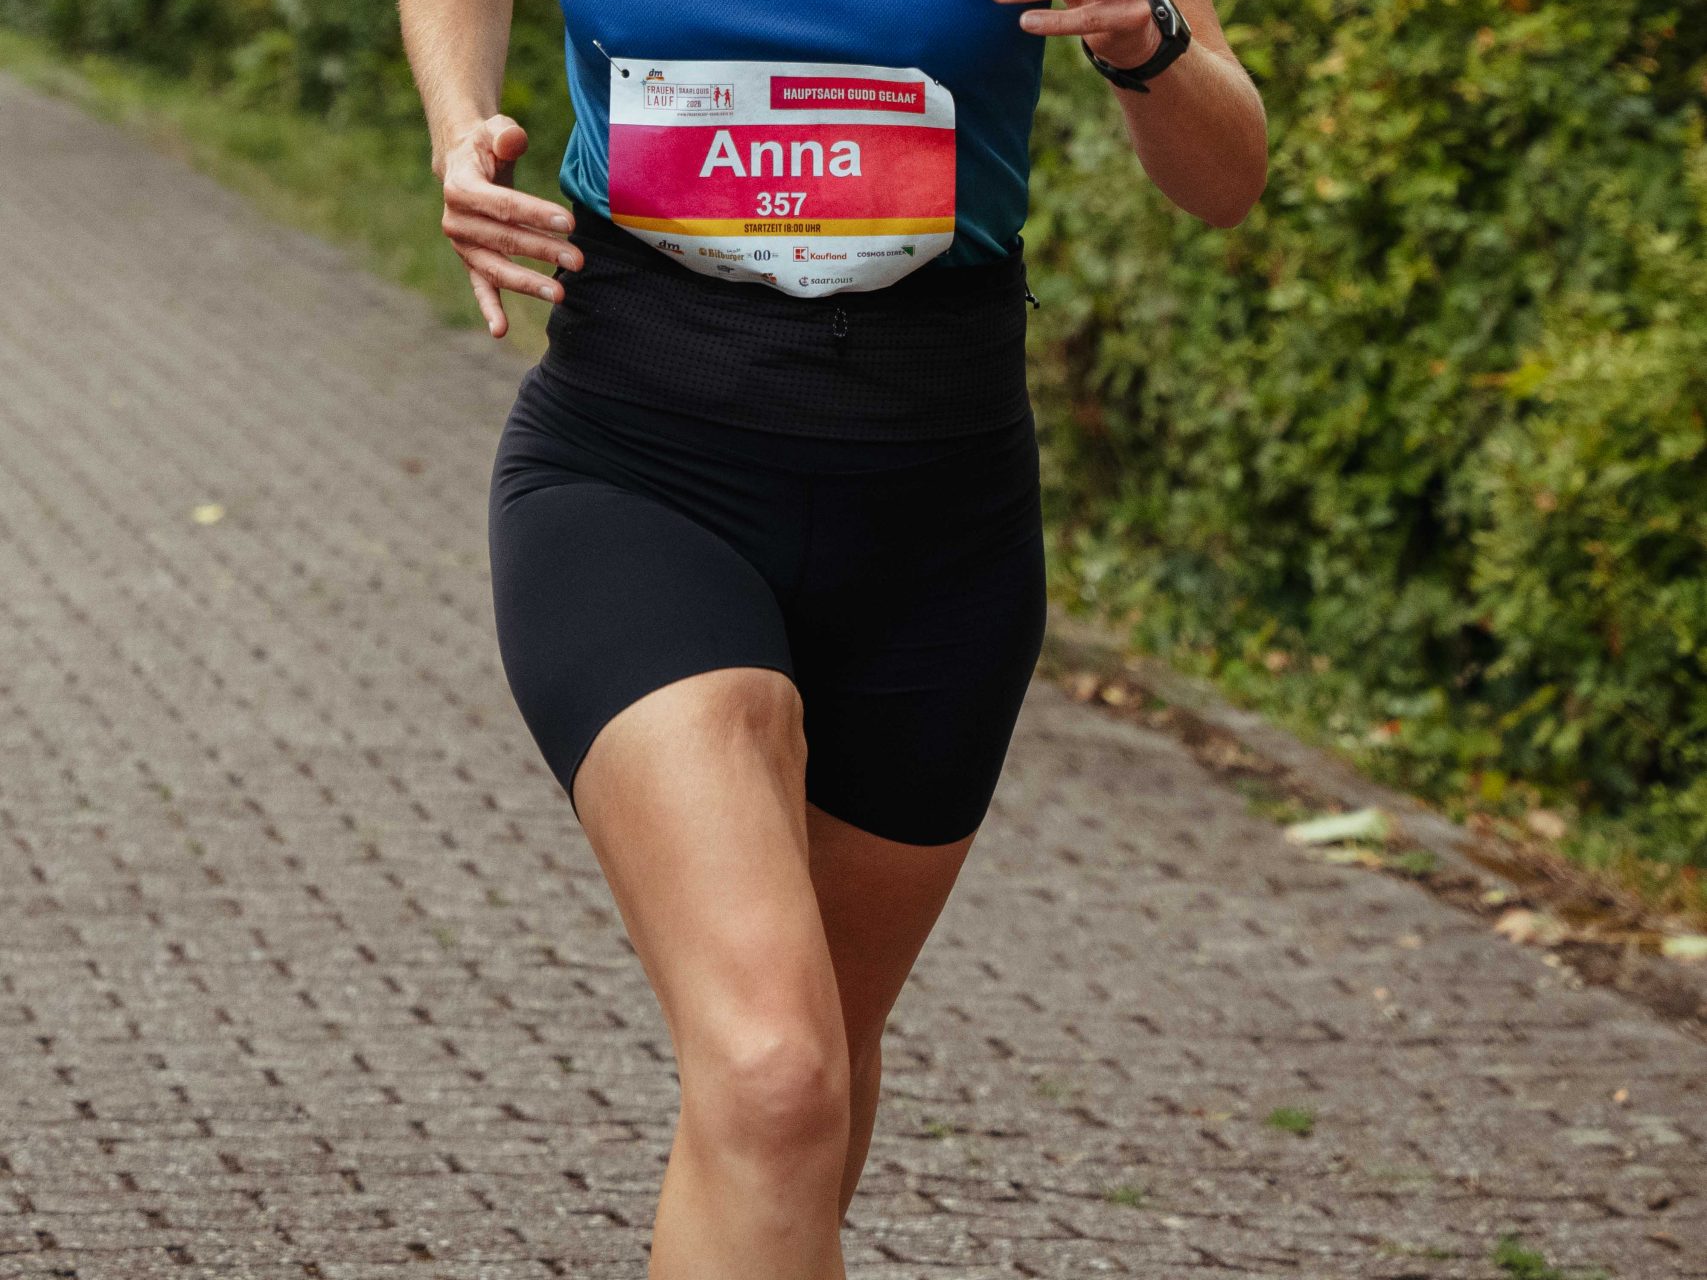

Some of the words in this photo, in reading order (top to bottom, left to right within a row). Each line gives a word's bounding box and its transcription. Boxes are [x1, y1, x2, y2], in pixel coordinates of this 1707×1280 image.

[649, 69, 663, 77] dm
[647, 85, 675, 95] FRAUEN
[678, 87, 710, 95] SAARLOUIS
[647, 95, 674, 107] LAUF
[783, 88, 845, 100] HAUPTSACH
[847, 88, 876, 101] GUDD
[879, 91, 917, 104] GELAAF
[698, 130, 862, 178] Anna
[756, 192, 807, 216] 357
[744, 223, 783, 233] STARTZEIT
[784, 223, 804, 233] 18:00
[805, 223, 821, 233] UHR
[658, 240, 680, 251] dm
[810, 252, 847, 260] Kaufland
